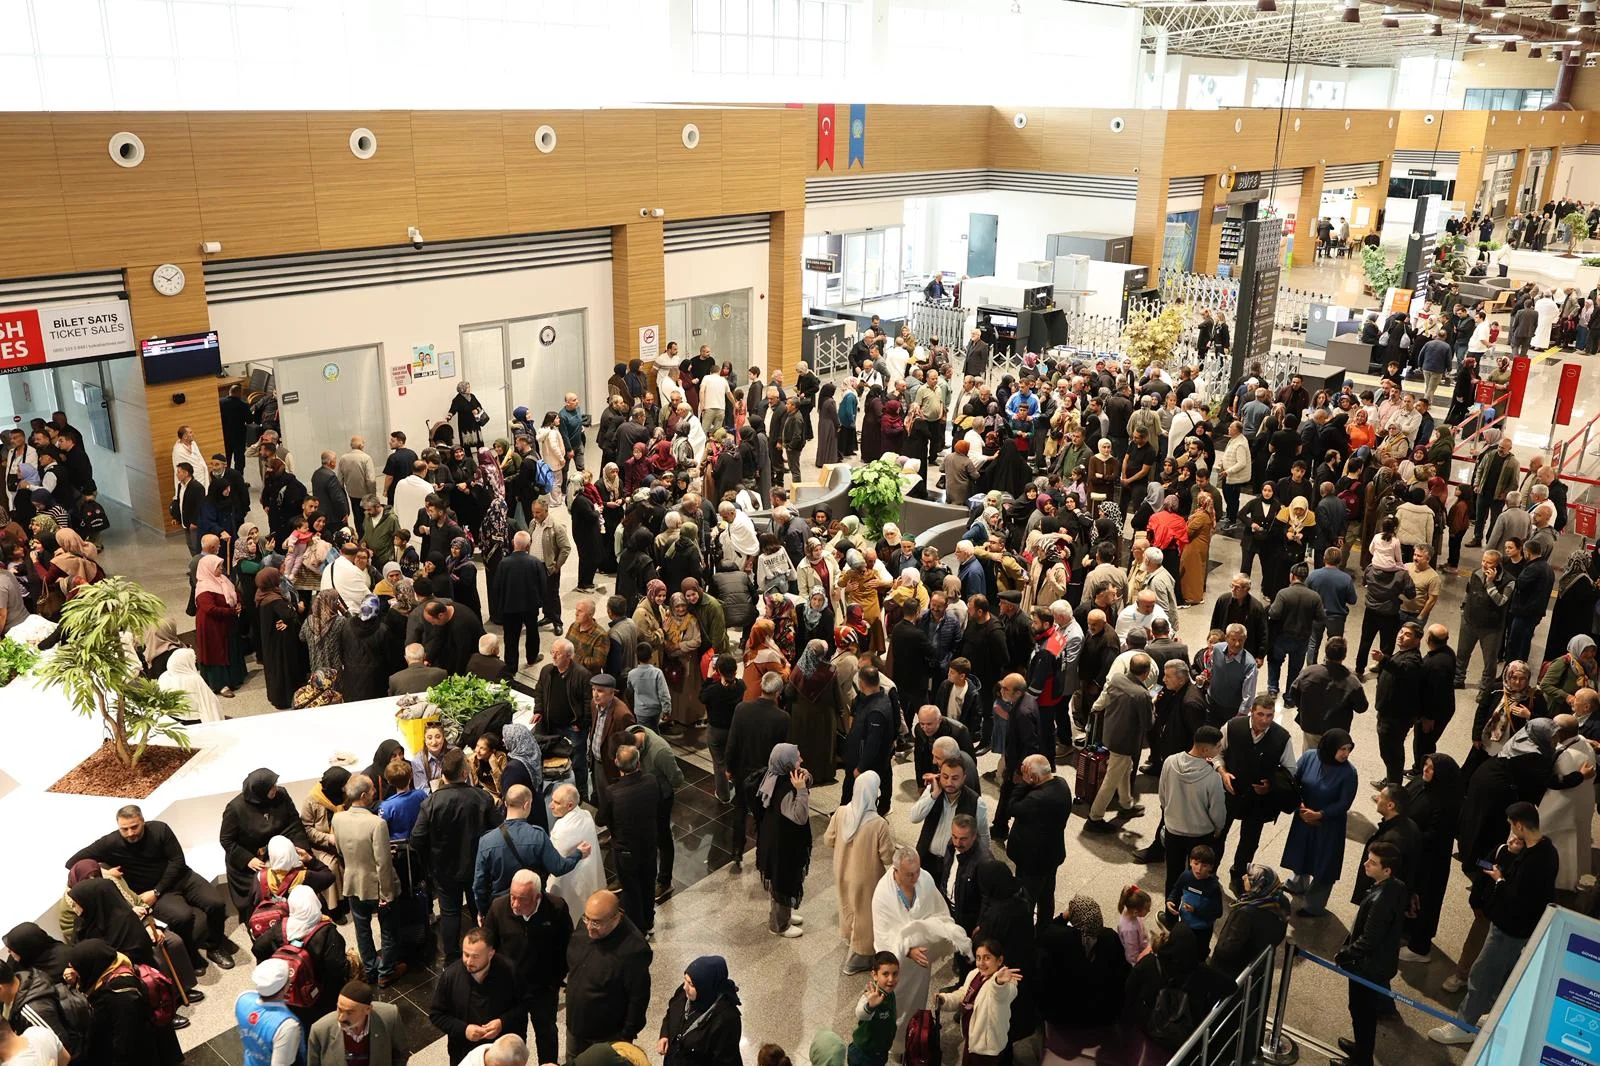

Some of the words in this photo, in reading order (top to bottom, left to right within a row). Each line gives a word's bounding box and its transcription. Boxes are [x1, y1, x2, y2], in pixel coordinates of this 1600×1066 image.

[53, 317, 84, 328] BİLET
[87, 313, 118, 325] SATIŞ
[50, 328, 88, 339] TICKET
[91, 323, 125, 335] SALES
